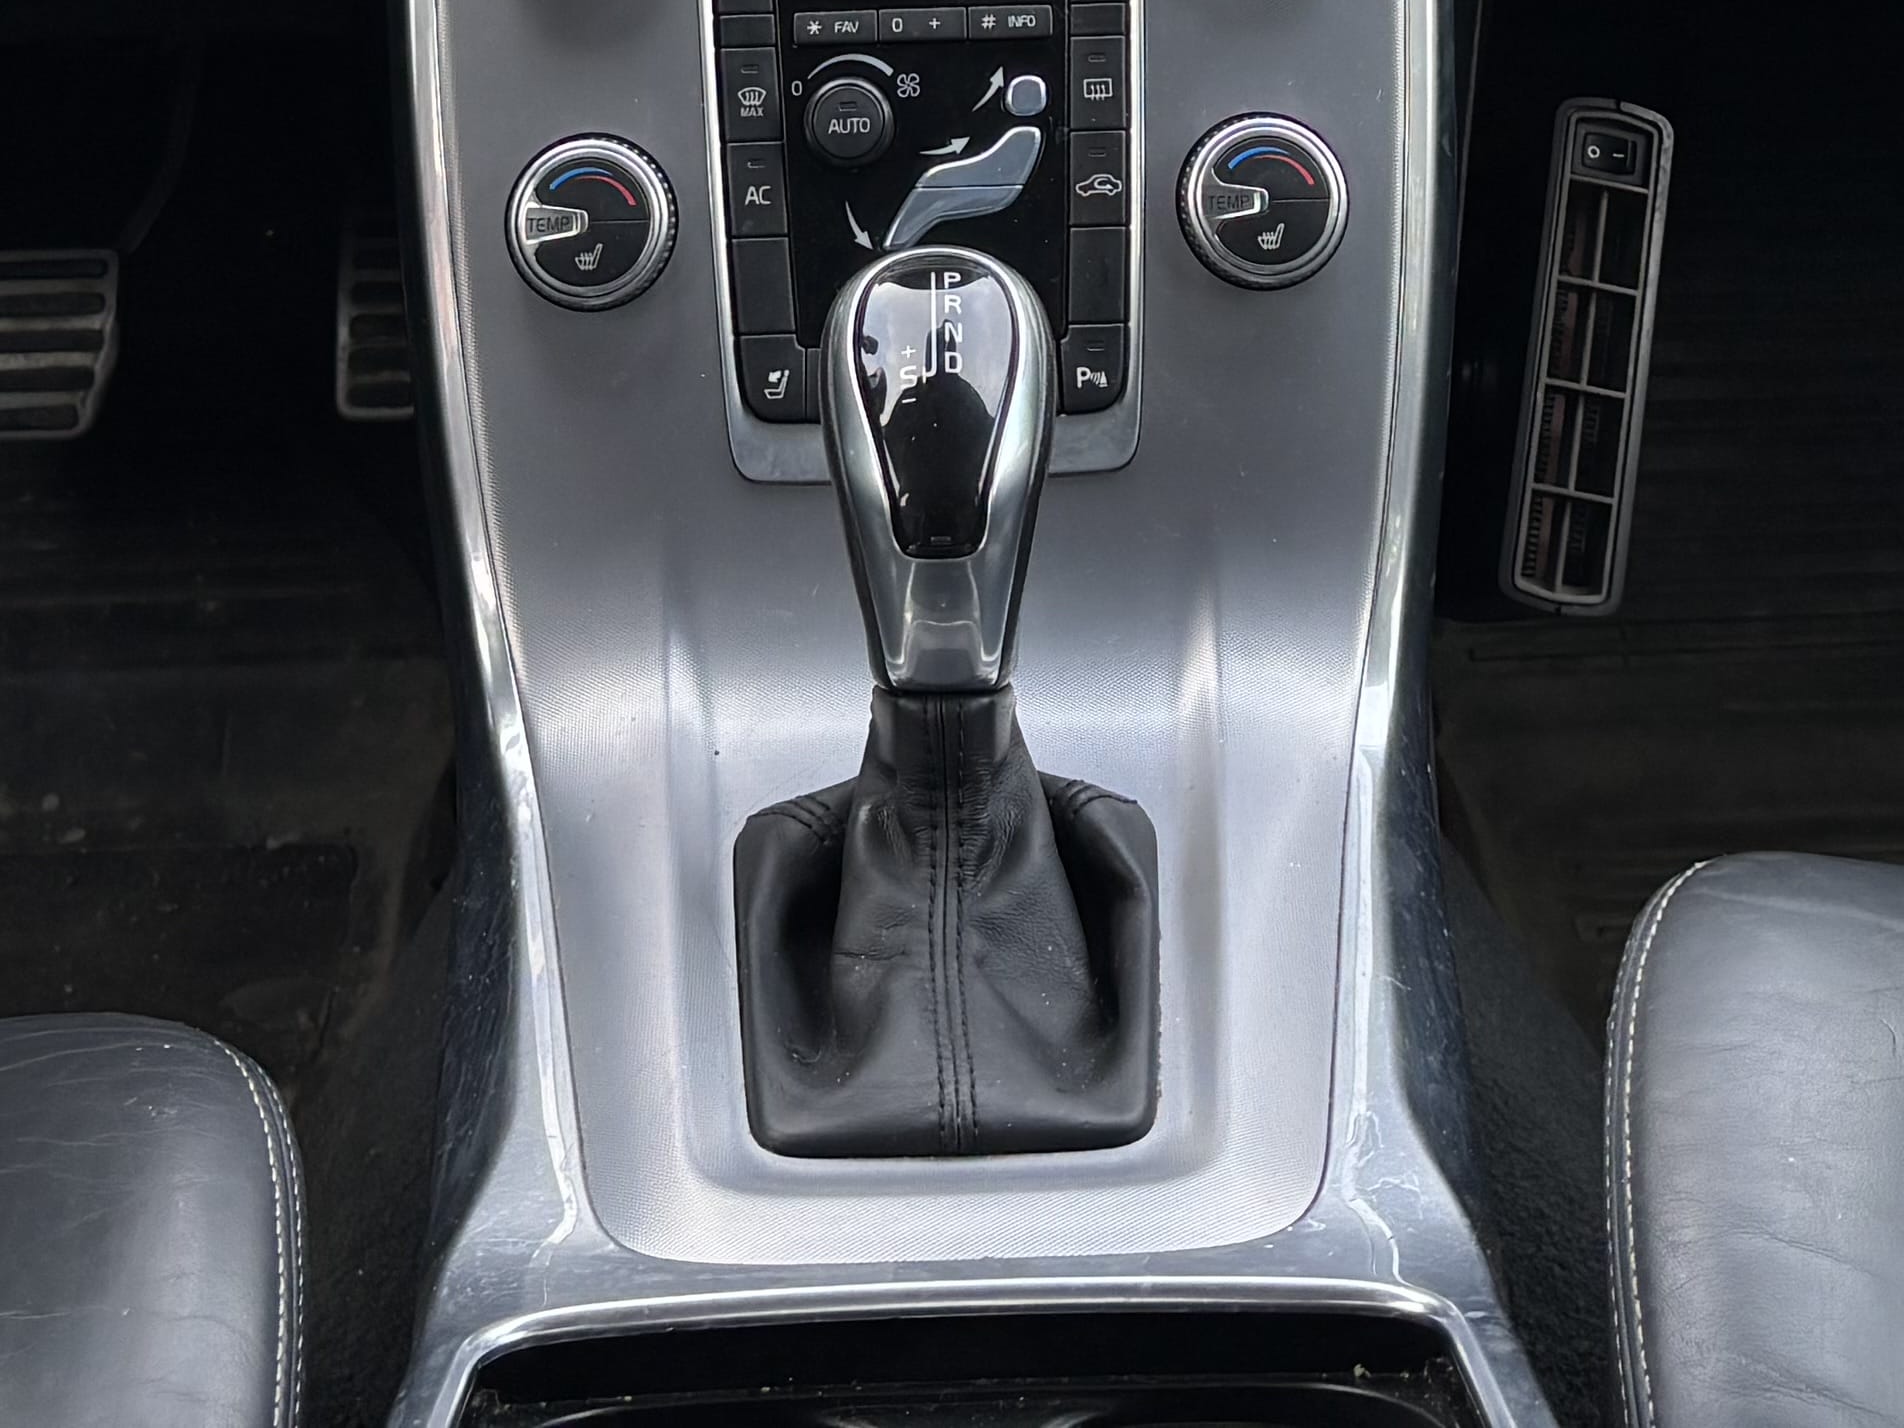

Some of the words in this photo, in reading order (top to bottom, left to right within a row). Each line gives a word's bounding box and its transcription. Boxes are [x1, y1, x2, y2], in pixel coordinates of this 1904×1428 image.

[834, 20, 860, 34] FAV
[1007, 14, 1037, 29] INFO
[828, 117, 871, 134] AUTO
[745, 186, 771, 205] AC
[1207, 194, 1252, 211] TEMP
[526, 216, 572, 233] TEMP
[943, 272, 961, 289] P
[944, 295, 962, 314] R
[944, 322, 963, 344] N
[944, 351, 963, 374] D
[899, 366, 916, 387] S
